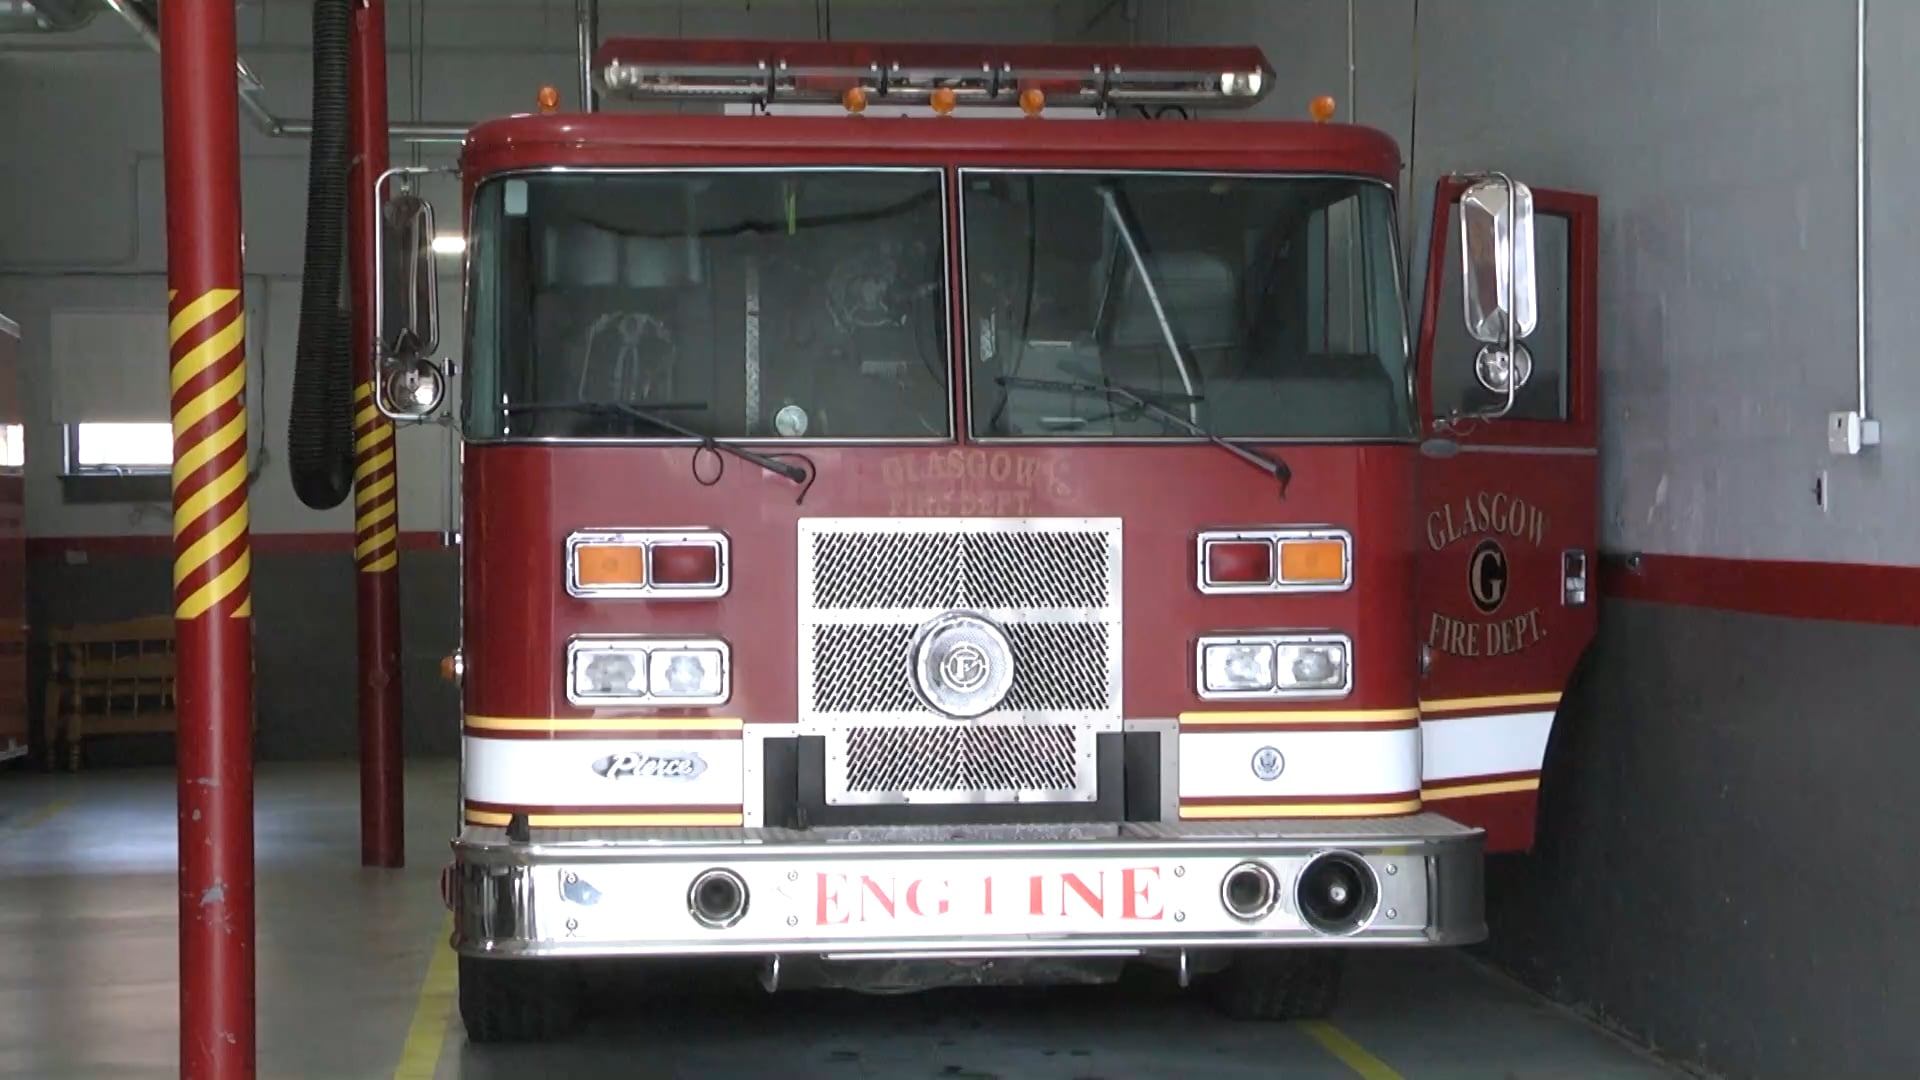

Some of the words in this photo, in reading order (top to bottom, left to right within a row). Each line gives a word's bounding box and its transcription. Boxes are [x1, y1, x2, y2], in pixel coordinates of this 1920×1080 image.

[1426, 491, 1550, 551] GLASGOW
[1471, 550, 1503, 603] G
[1429, 612, 1480, 657] FIRE
[1486, 608, 1548, 657] DEPT.
